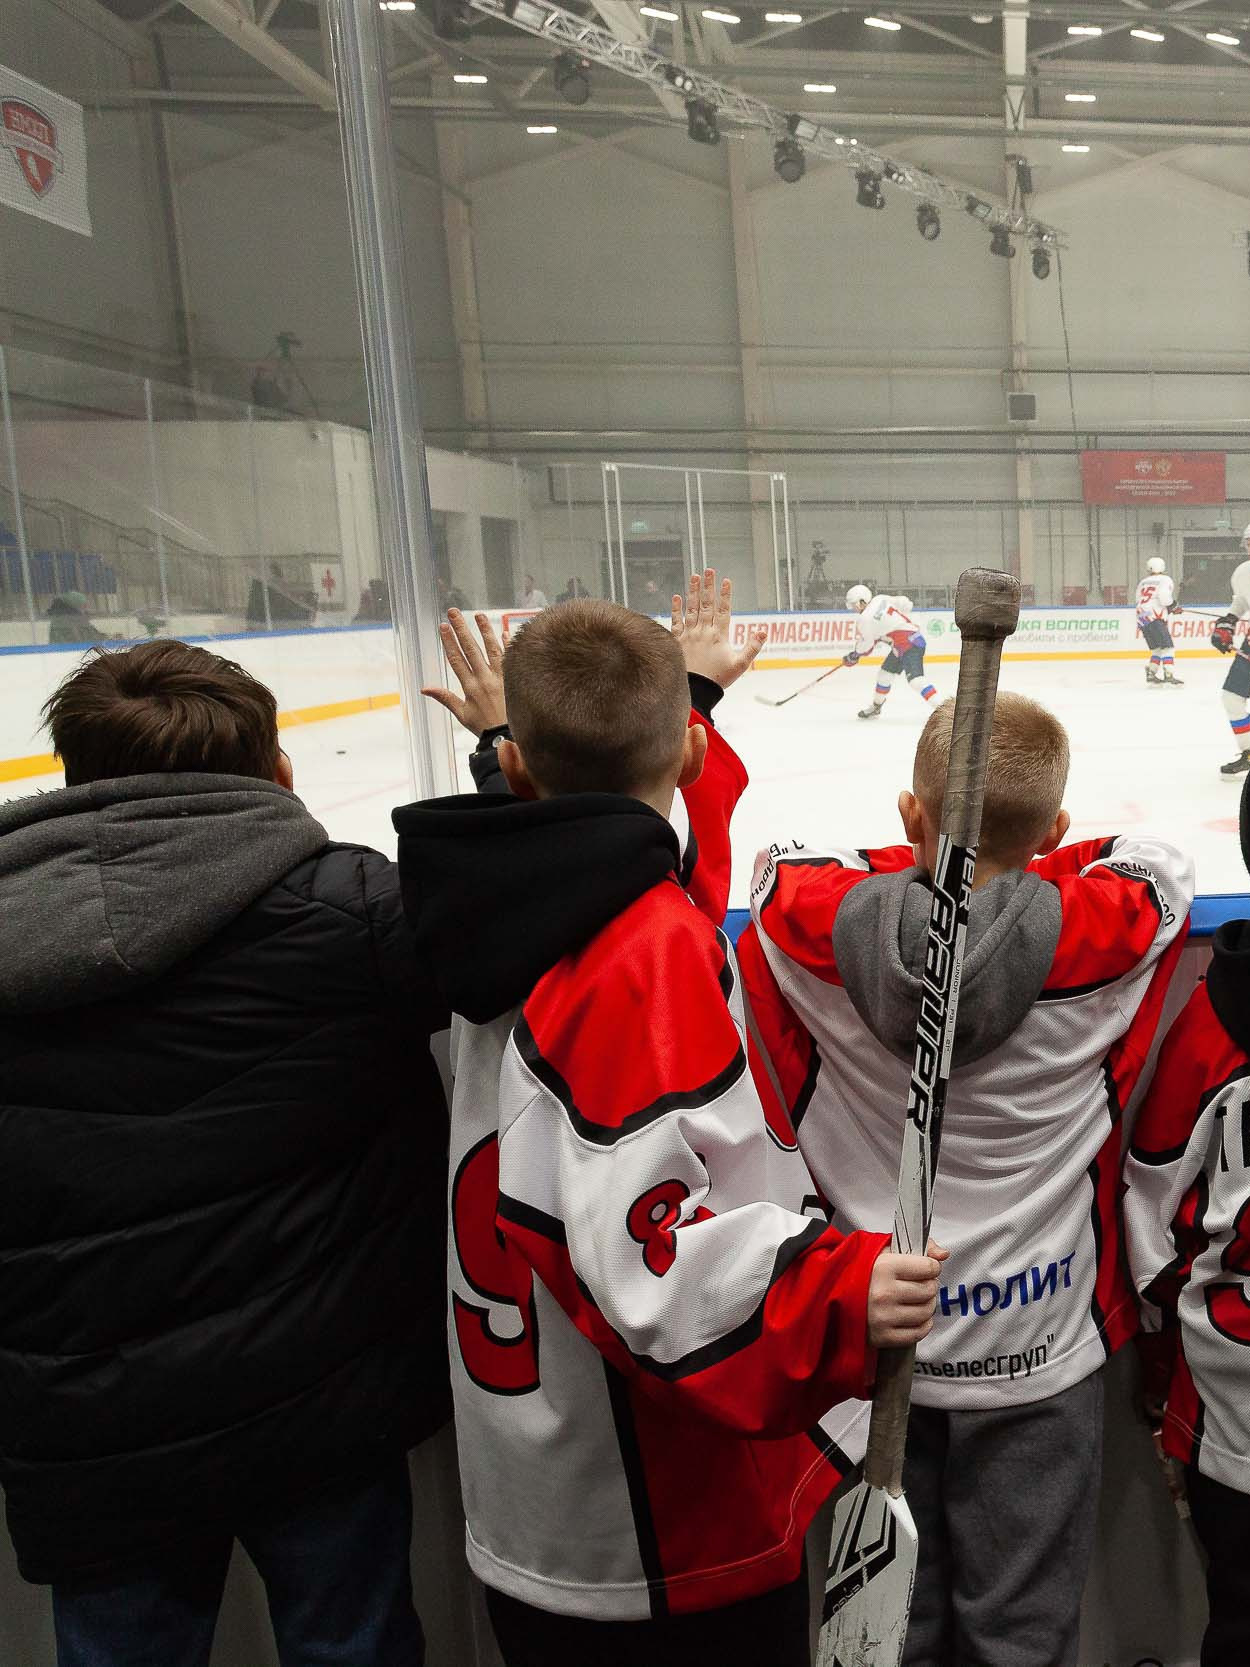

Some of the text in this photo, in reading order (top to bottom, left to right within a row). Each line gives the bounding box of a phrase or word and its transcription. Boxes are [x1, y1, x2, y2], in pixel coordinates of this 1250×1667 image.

[734, 620, 862, 645] REMACHINE
[952, 959, 961, 994] JUNIOR
[939, 1250, 1077, 1317] НОЛИТ
[913, 1333, 1055, 1381] стьелесгруп"
